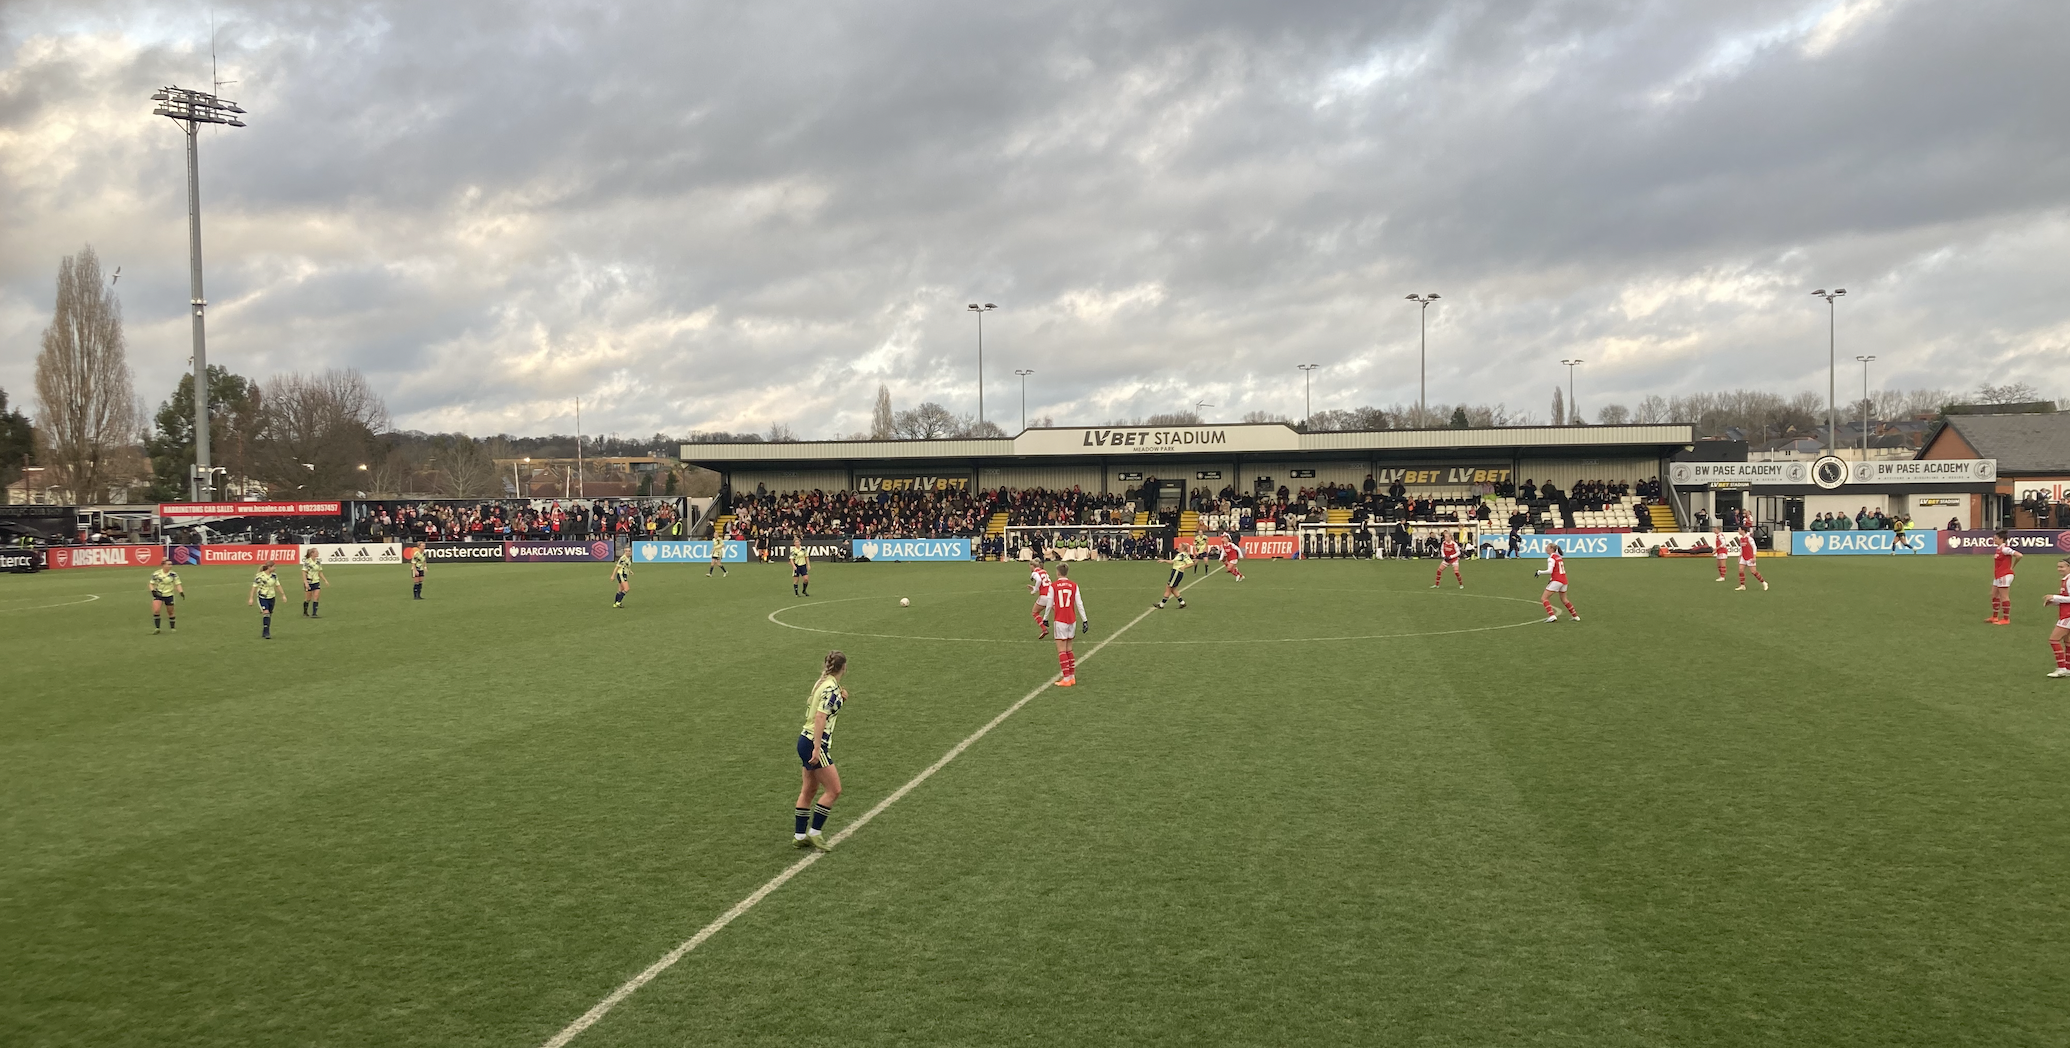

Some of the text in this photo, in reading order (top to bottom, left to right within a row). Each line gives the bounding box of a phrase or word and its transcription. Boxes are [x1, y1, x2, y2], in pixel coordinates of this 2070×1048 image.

[1154, 430, 1226, 445] STADIUM
[1695, 465, 1782, 475] BW PASE ACADEMY
[1878, 463, 1970, 474] BW PASE ACADEMY
[204, 505, 216, 513] CAR
[216, 505, 234, 513] SALES
[237, 504, 295, 513] www.hcsales.co.uk
[1244, 541, 1293, 554] FLY BETTER
[1963, 537, 2054, 547] BARCLYS WSL
[205, 549, 253, 561] Emirates
[256, 549, 270, 561] FLY
[270, 549, 296, 561] BETTER
[425, 544, 504, 558] mastercard
[520, 547, 589, 556] BARCLAYS WSL
[661, 545, 738, 559] BARCLYS
[882, 542, 961, 557] BARCLAYS
[72, 548, 129, 567] ARSENAL
[1058, 589, 1072, 608] 17
